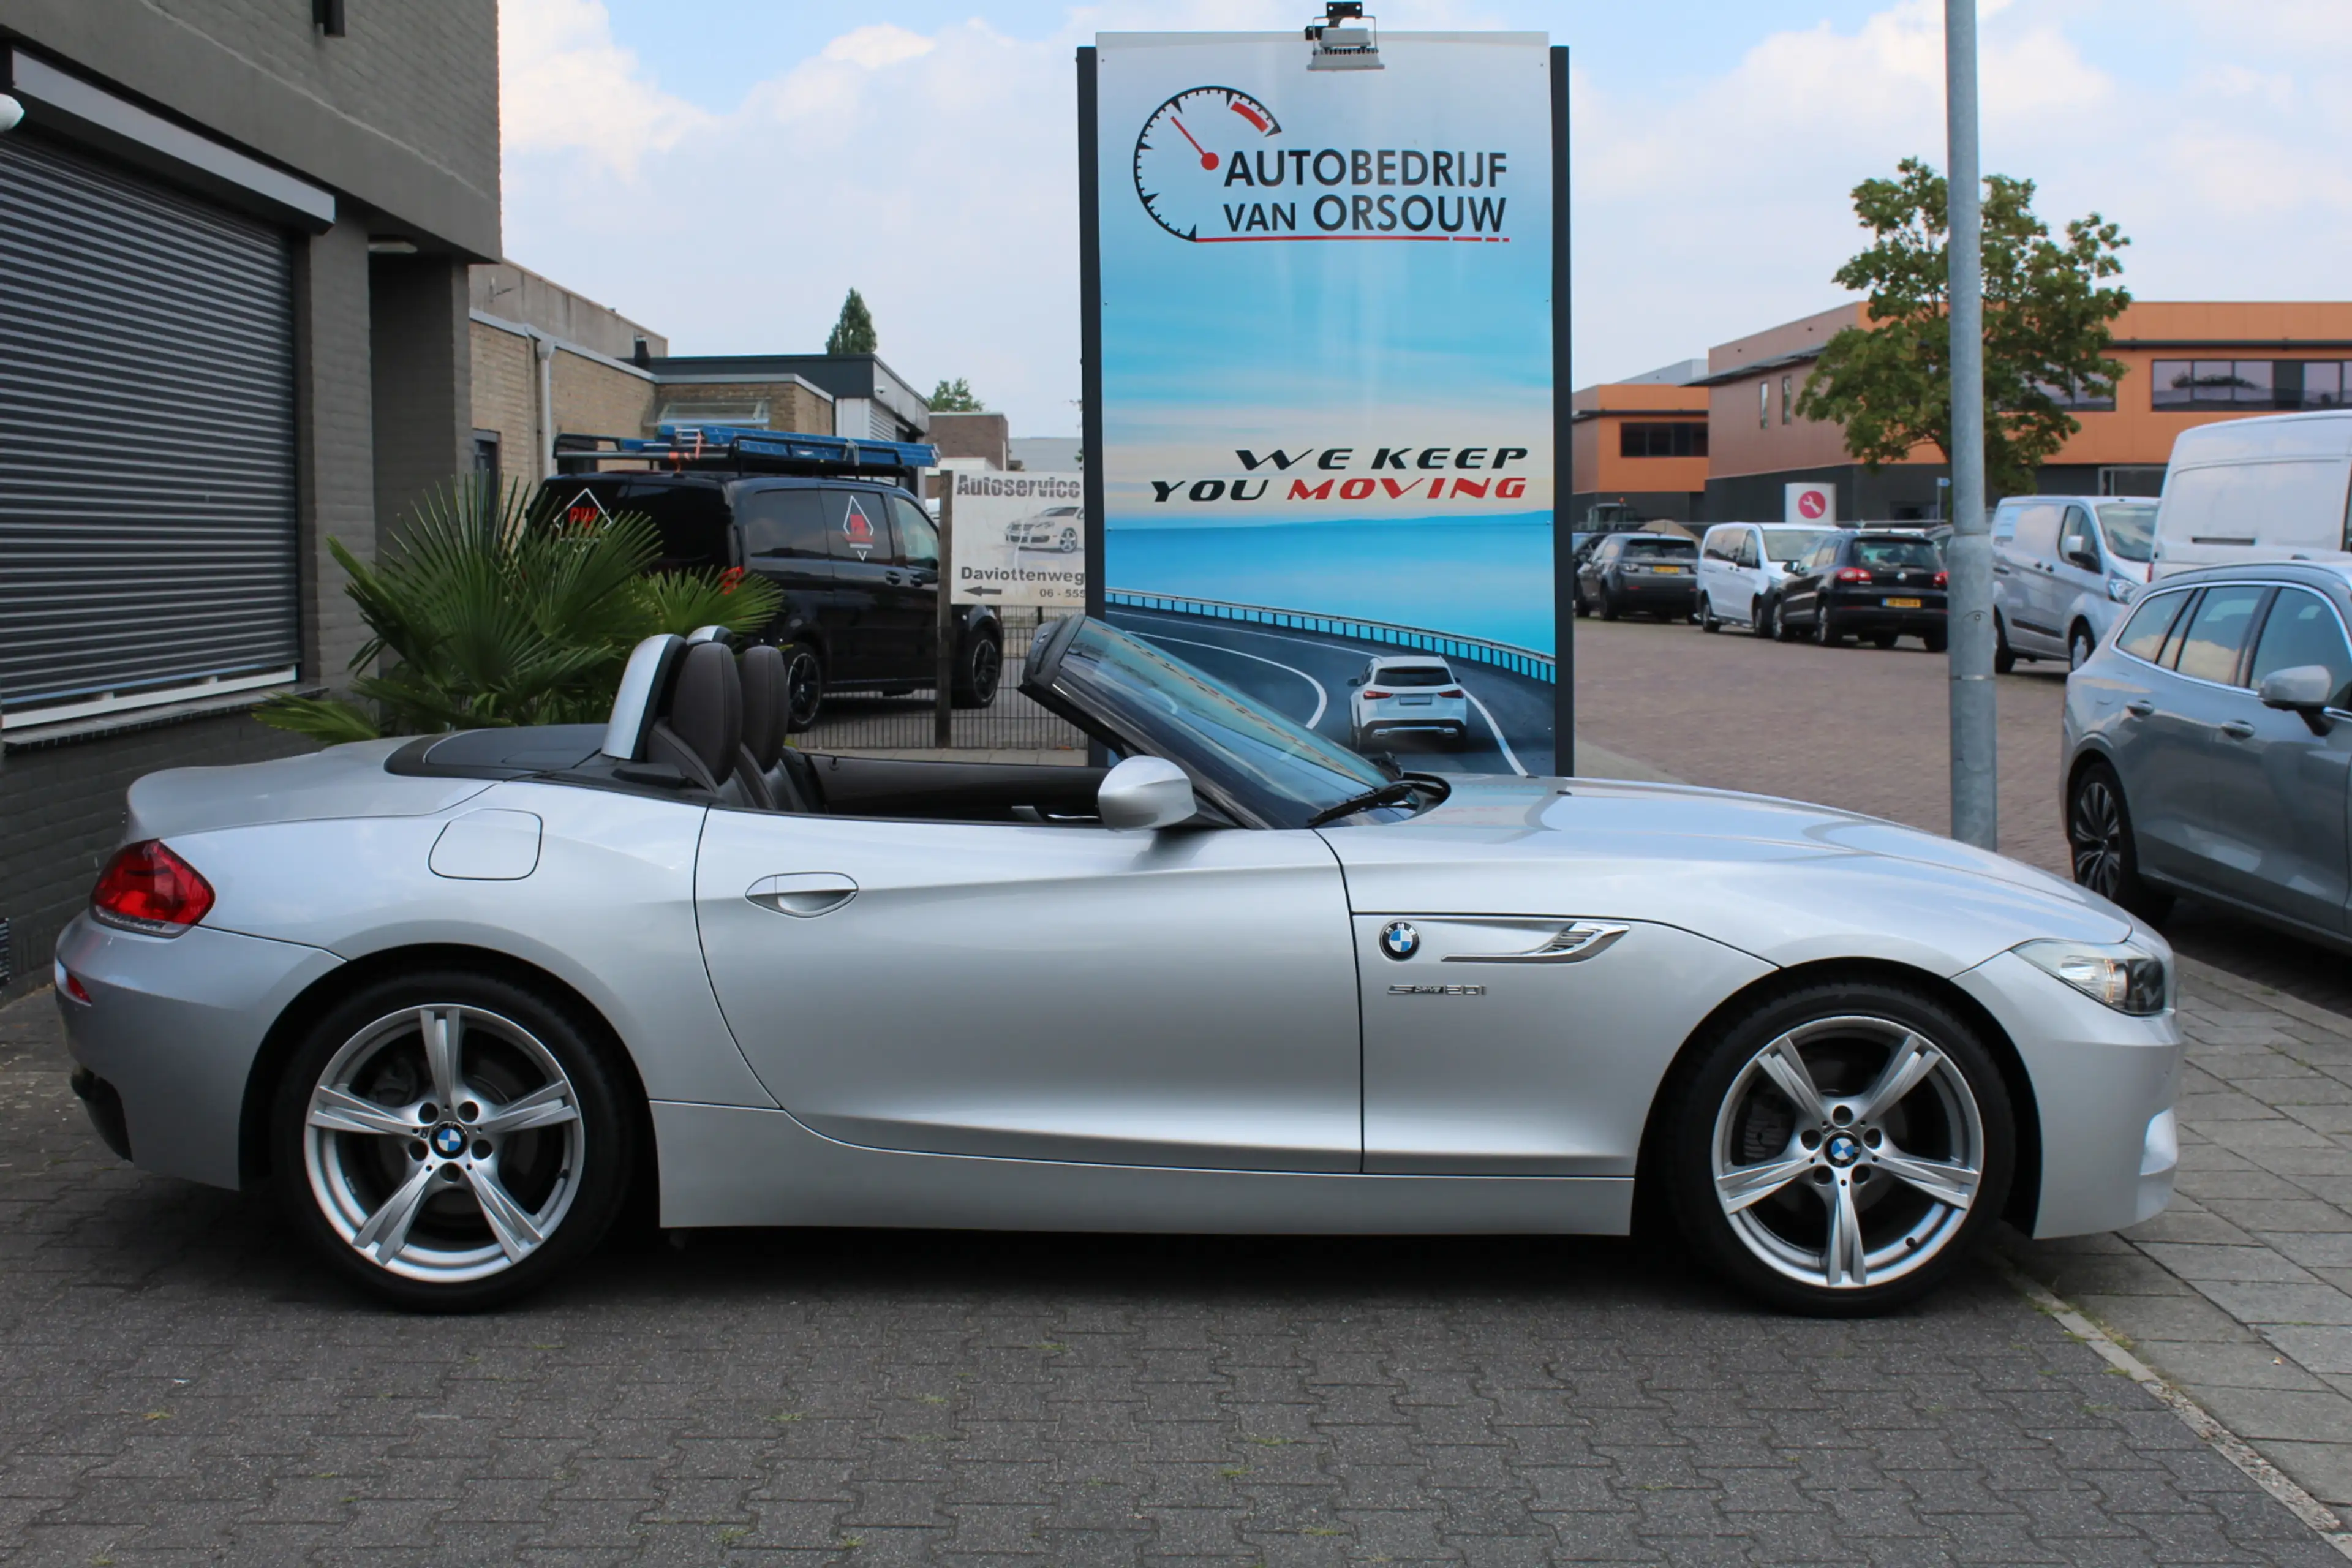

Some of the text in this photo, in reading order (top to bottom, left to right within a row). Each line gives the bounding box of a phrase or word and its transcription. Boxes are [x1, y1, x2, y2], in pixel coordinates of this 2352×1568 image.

[1224, 149, 1507, 187] AUTOBEDRIJF
[1223, 194, 1506, 233] VAN ORSOUW
[1235, 447, 1528, 471] WE KEEP
[956, 475, 1080, 499] Autoservice
[1151, 477, 1527, 503] YOU MOVING
[960, 567, 1085, 586] Daviottenweg
[1039, 589, 1054, 598] 06
